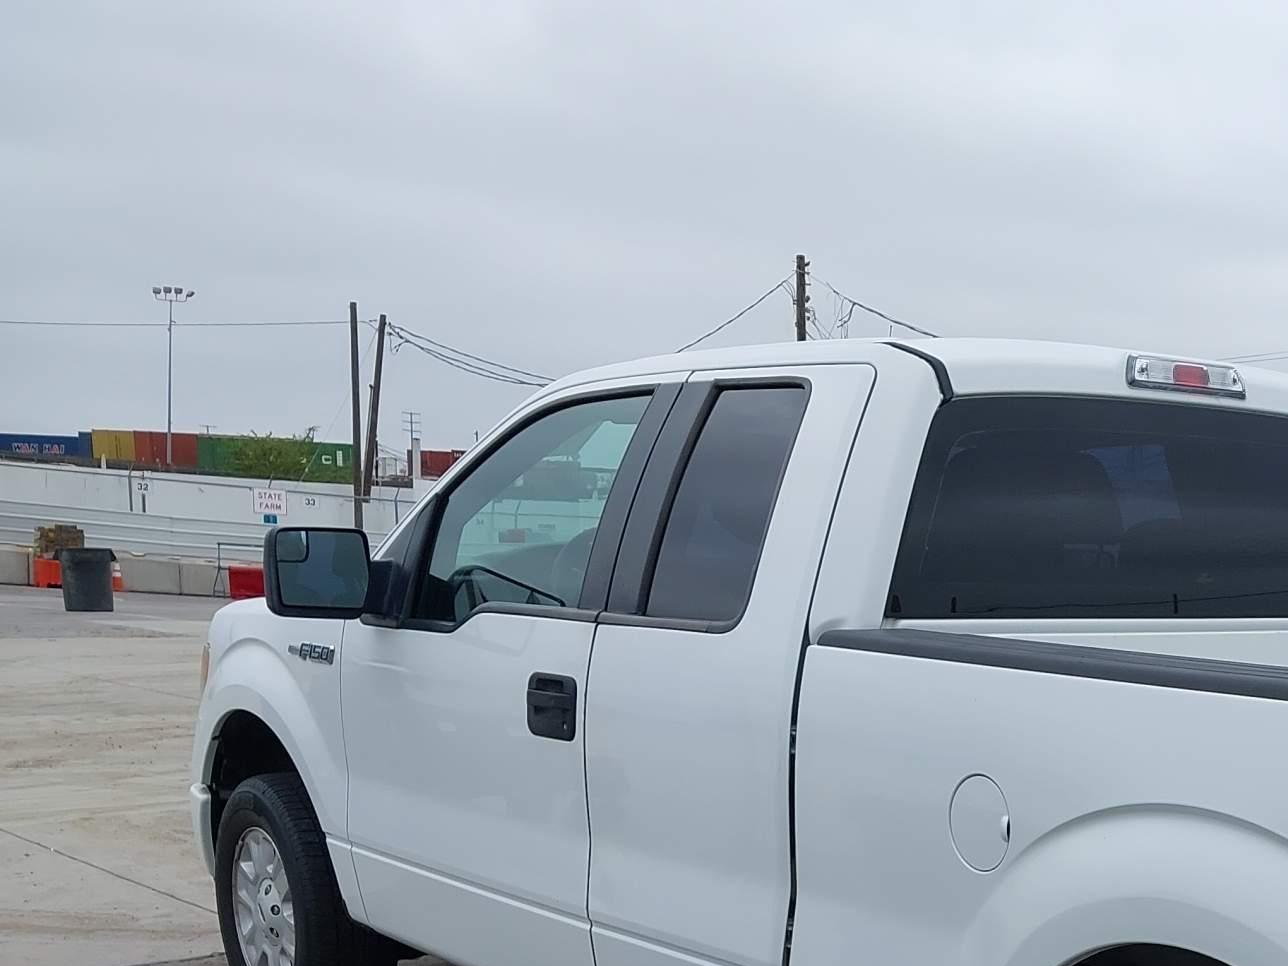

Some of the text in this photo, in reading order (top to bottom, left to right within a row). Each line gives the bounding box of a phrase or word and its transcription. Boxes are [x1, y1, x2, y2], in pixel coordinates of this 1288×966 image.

[12, 442, 65, 455] WAN HAI
[137, 482, 149, 491] 32
[257, 491, 283, 500] STATE
[305, 497, 316, 506] 33
[259, 502, 282, 511] FARM
